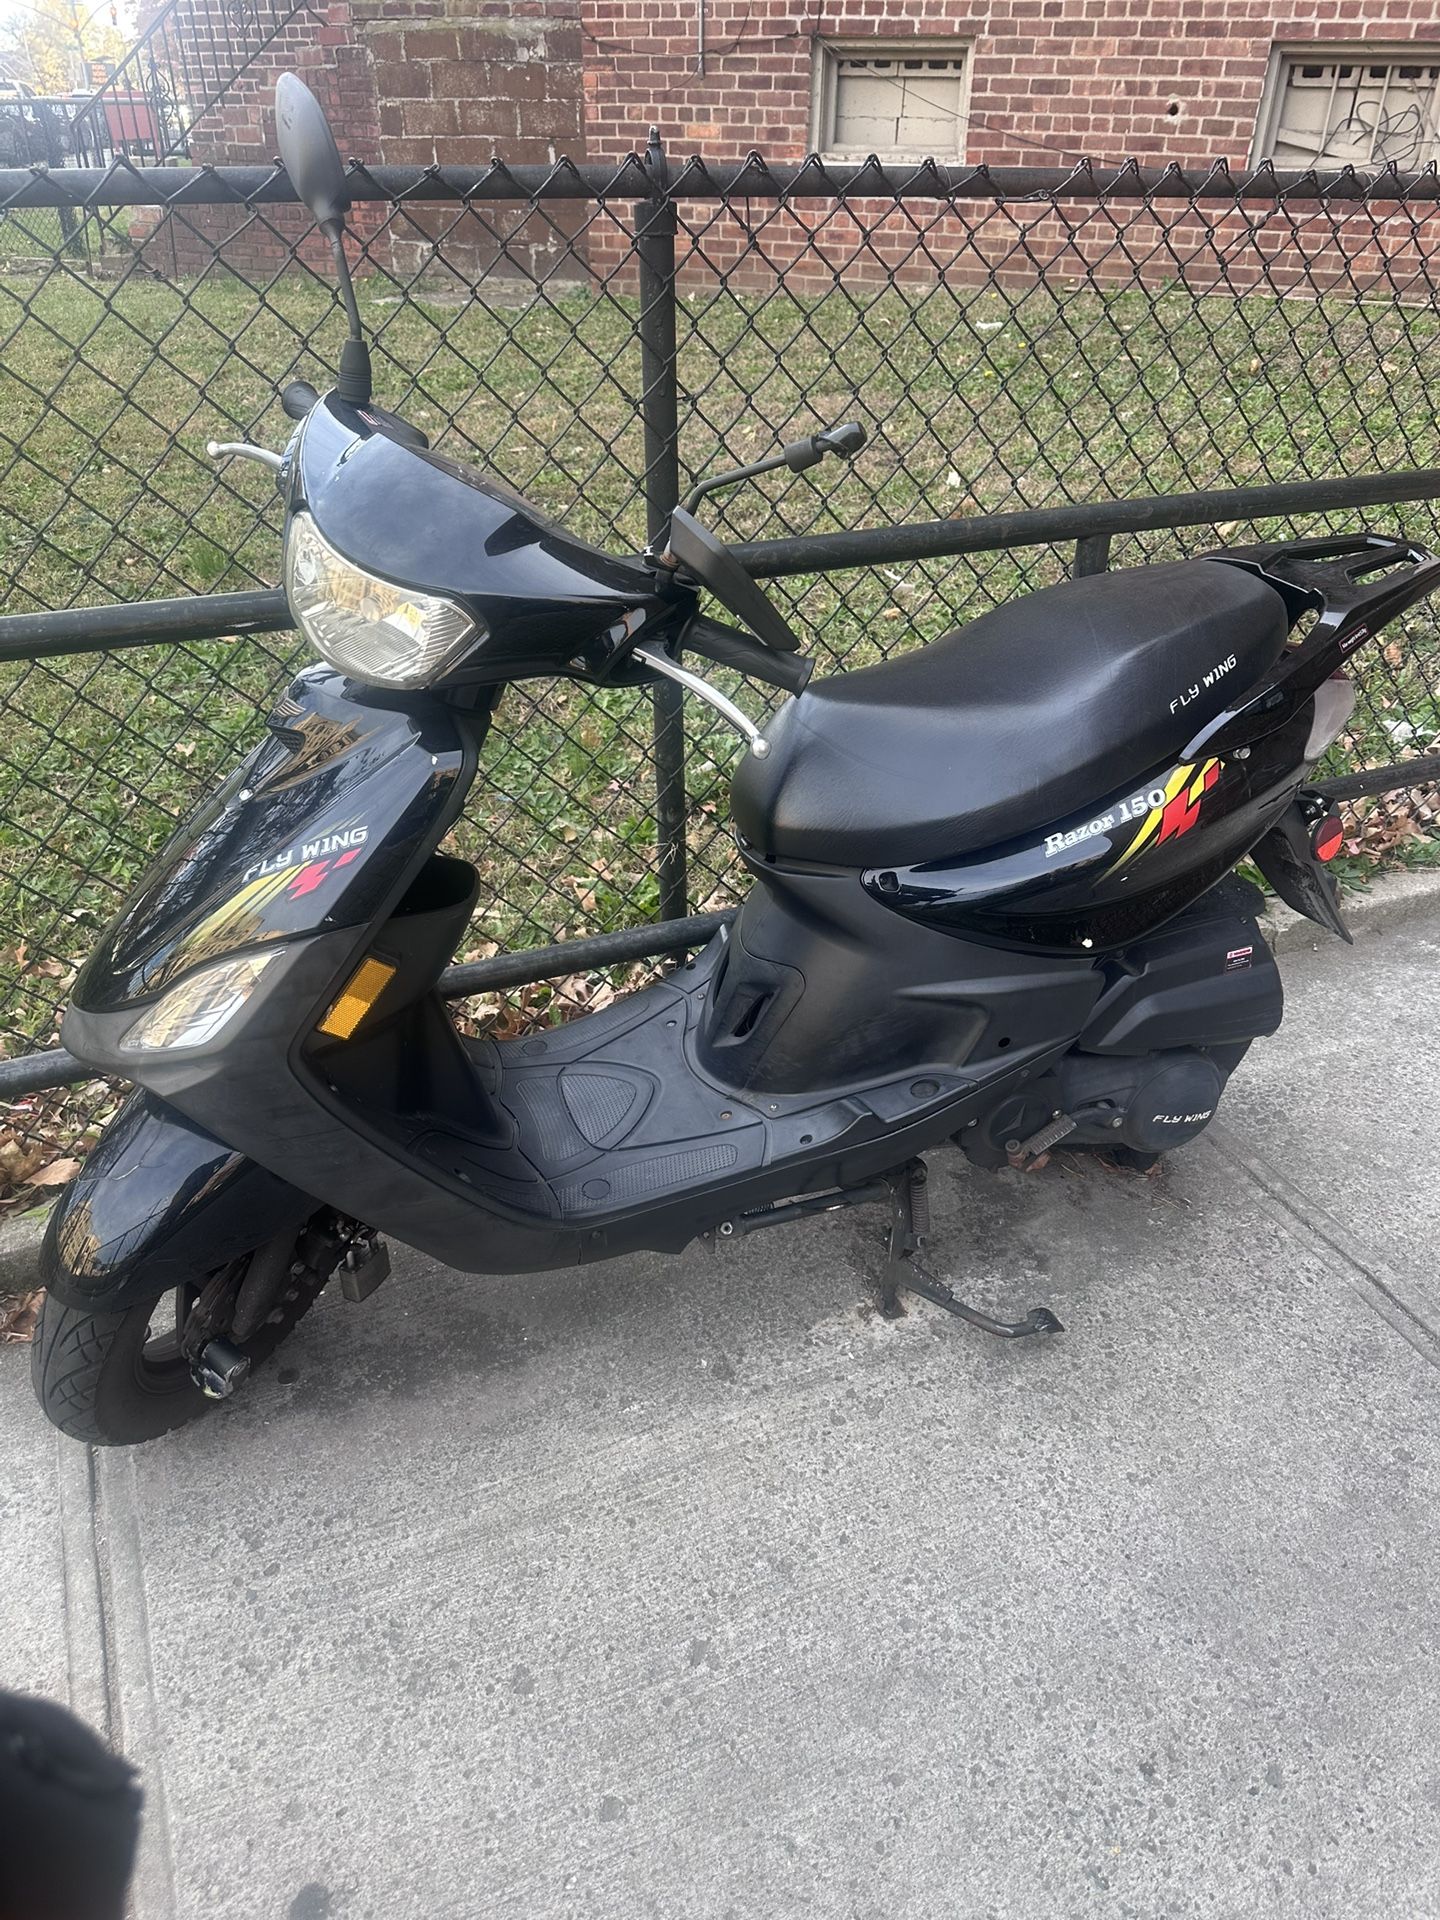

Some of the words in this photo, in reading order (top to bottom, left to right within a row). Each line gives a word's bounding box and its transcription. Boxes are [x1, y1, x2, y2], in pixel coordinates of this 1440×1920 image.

[1169, 684, 1200, 714] FLY
[1202, 653, 1237, 688] WING
[1043, 814, 1115, 858] Razor
[1118, 788, 1166, 823] 150
[241, 849, 294, 884] FLY
[301, 825, 369, 861] WING
[1152, 1114, 1183, 1124] FLY
[1184, 1109, 1212, 1123] WING
